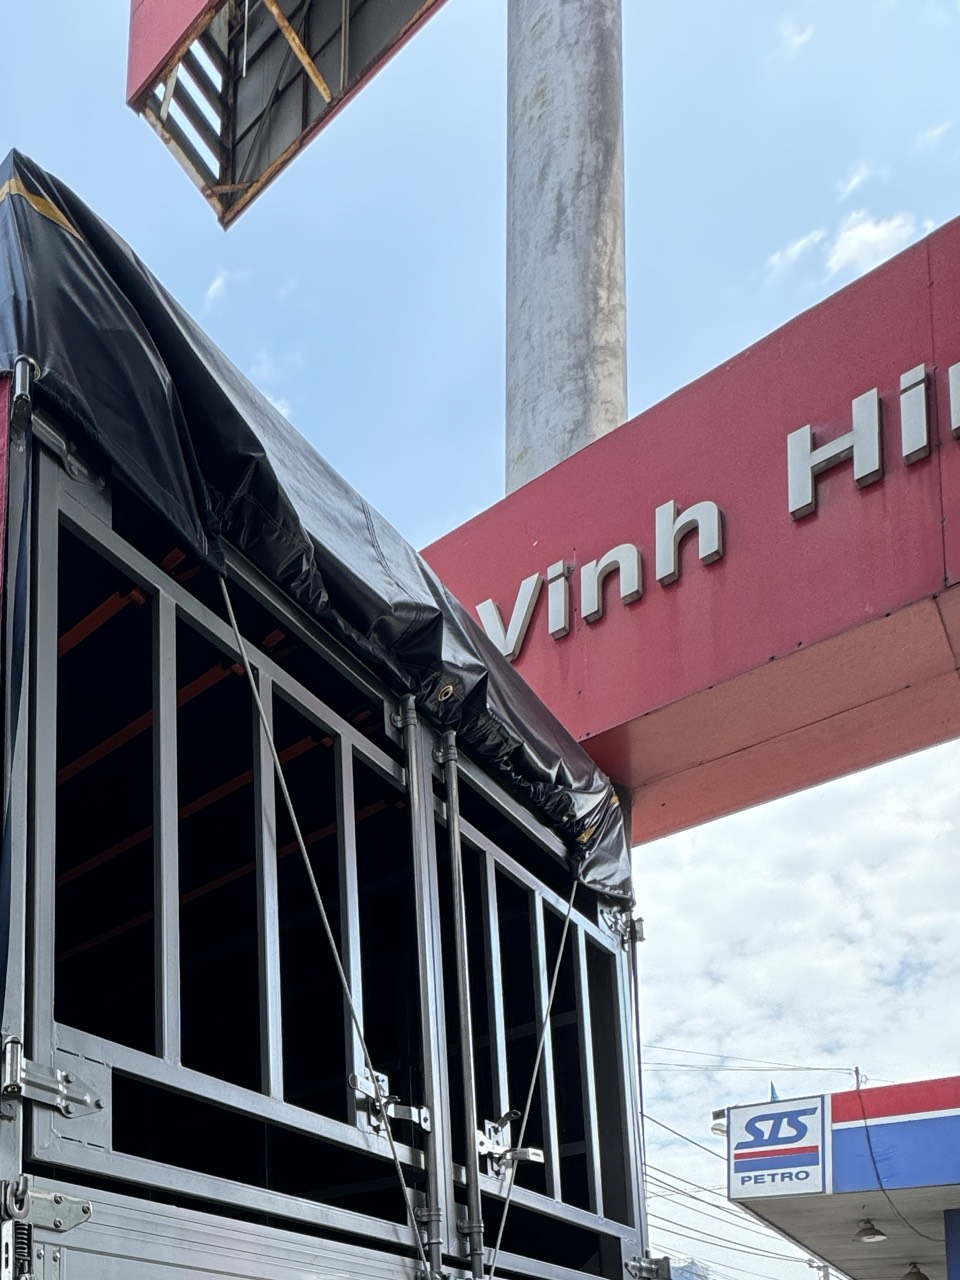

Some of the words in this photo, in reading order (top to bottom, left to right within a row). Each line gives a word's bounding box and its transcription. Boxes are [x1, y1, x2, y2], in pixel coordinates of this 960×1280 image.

[475, 500, 723, 663] Vinh
[786, 362, 960, 521] Hi
[733, 1106, 819, 1151] STS
[740, 1170, 810, 1186] PETRO
